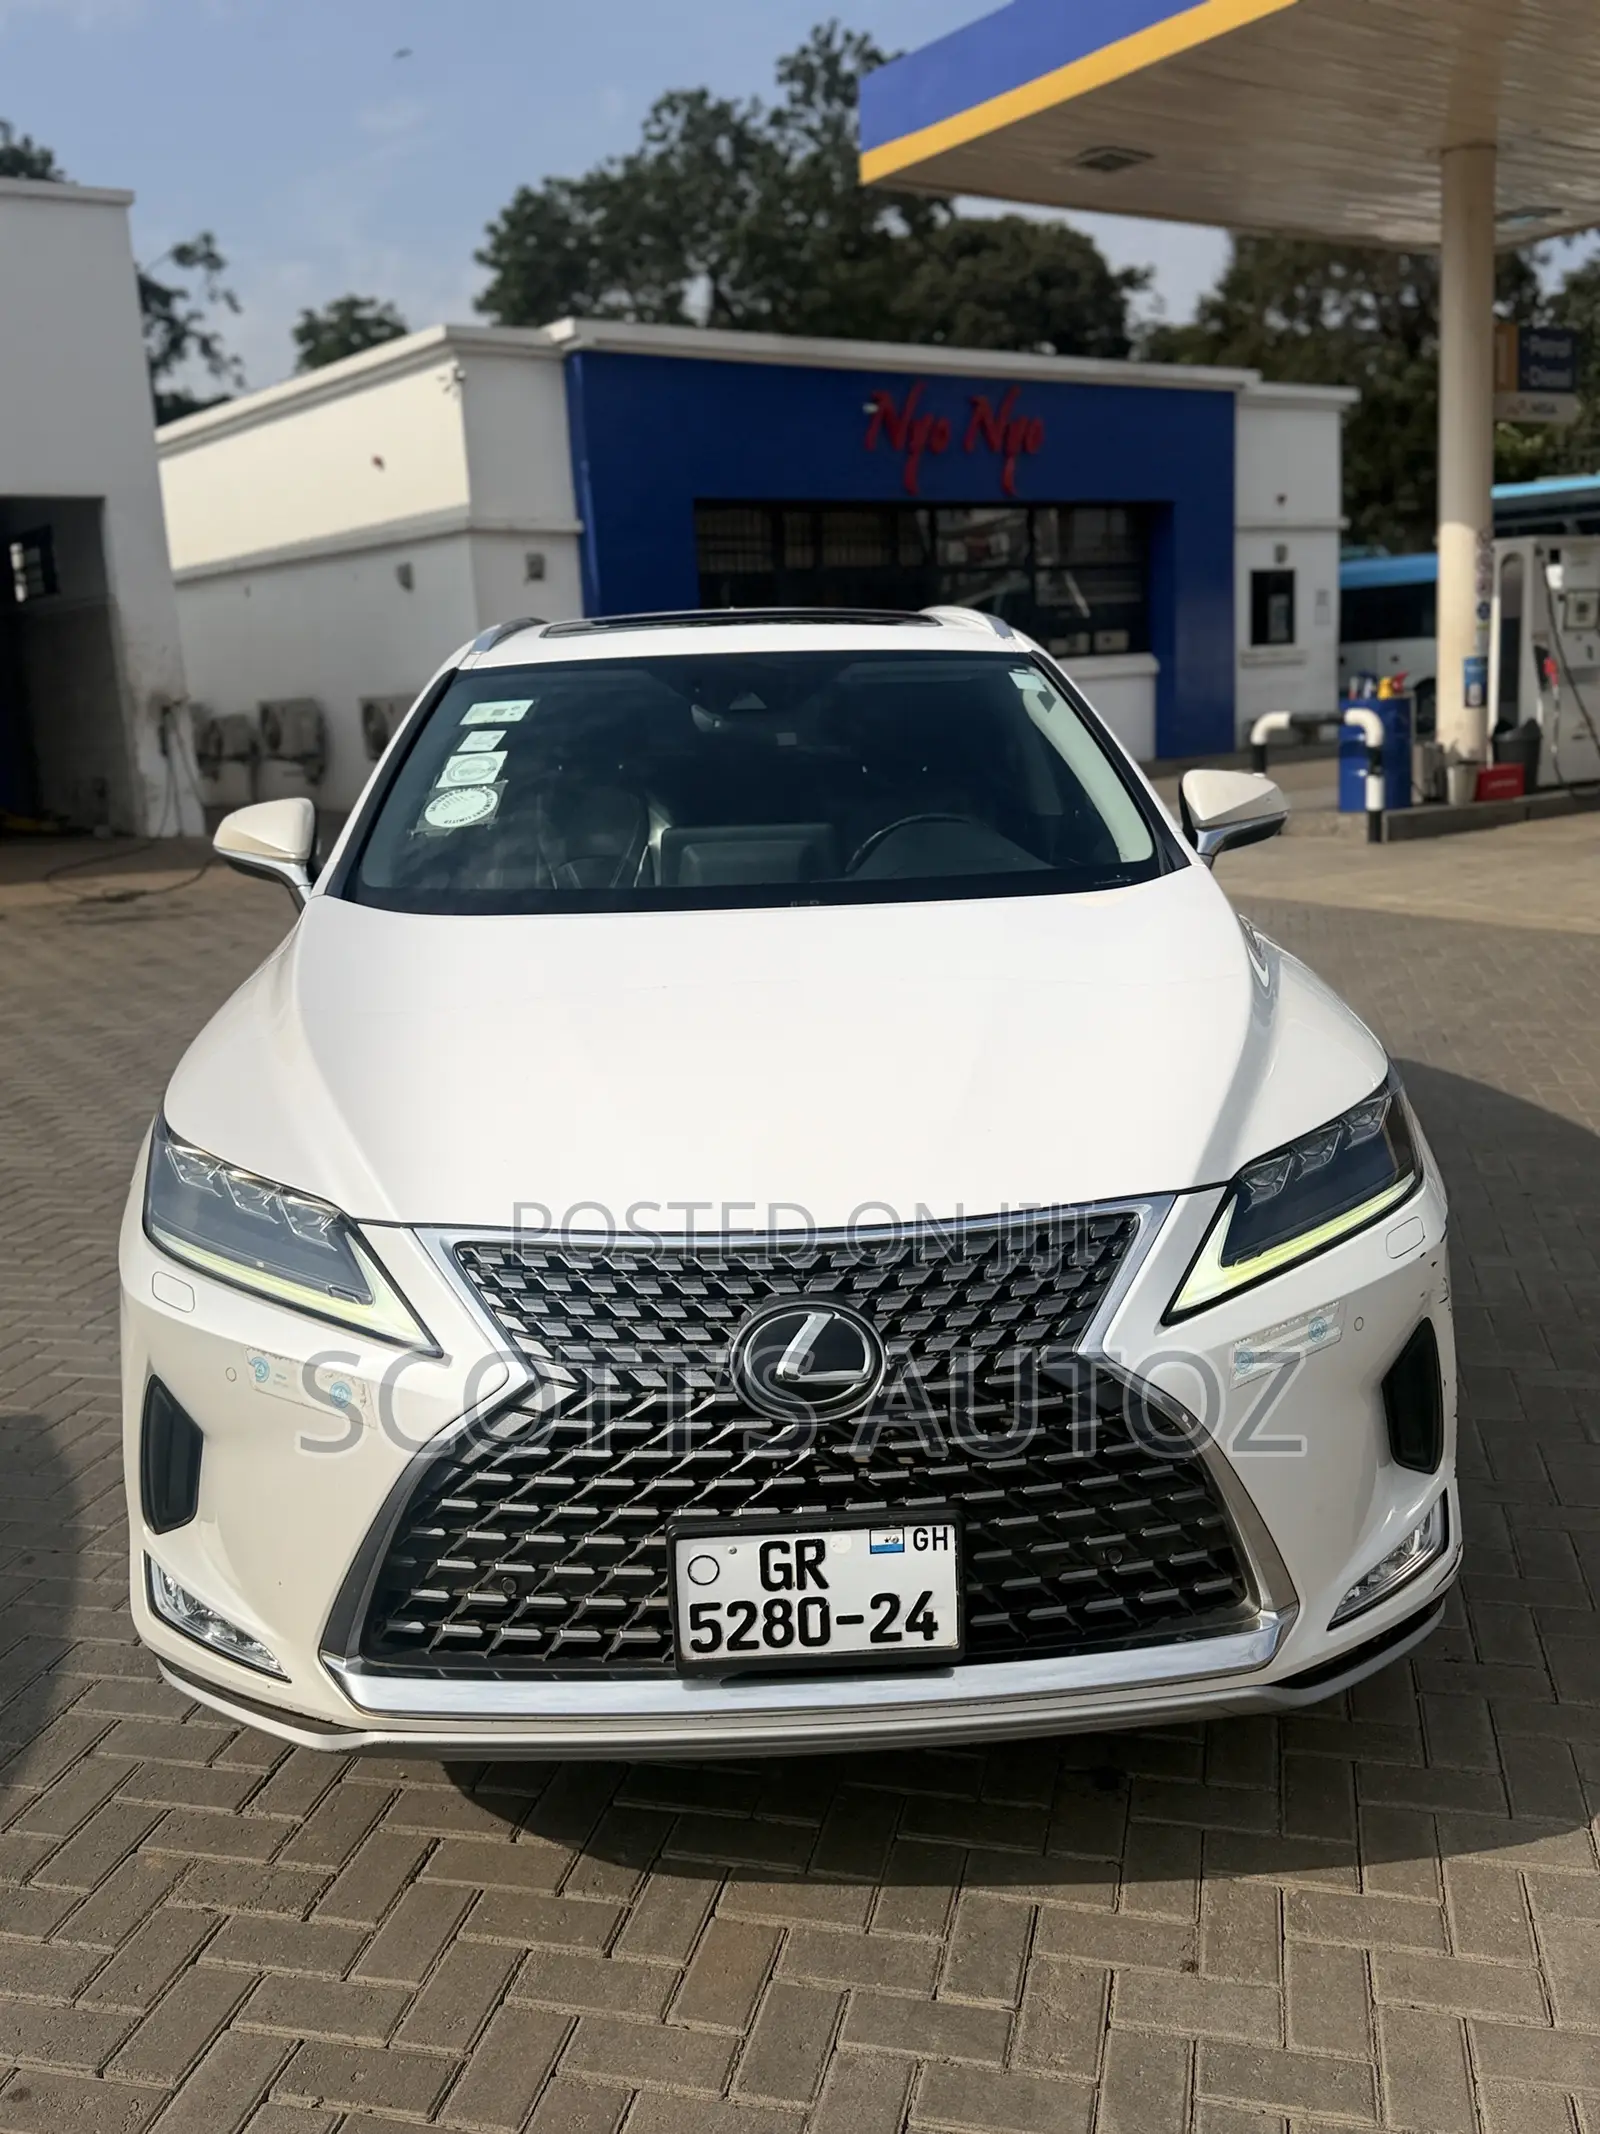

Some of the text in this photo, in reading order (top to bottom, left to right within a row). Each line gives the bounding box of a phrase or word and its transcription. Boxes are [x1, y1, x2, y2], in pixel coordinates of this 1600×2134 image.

[759, 1526, 949, 1592] GR GH
[689, 1590, 939, 1653] 5280-24
